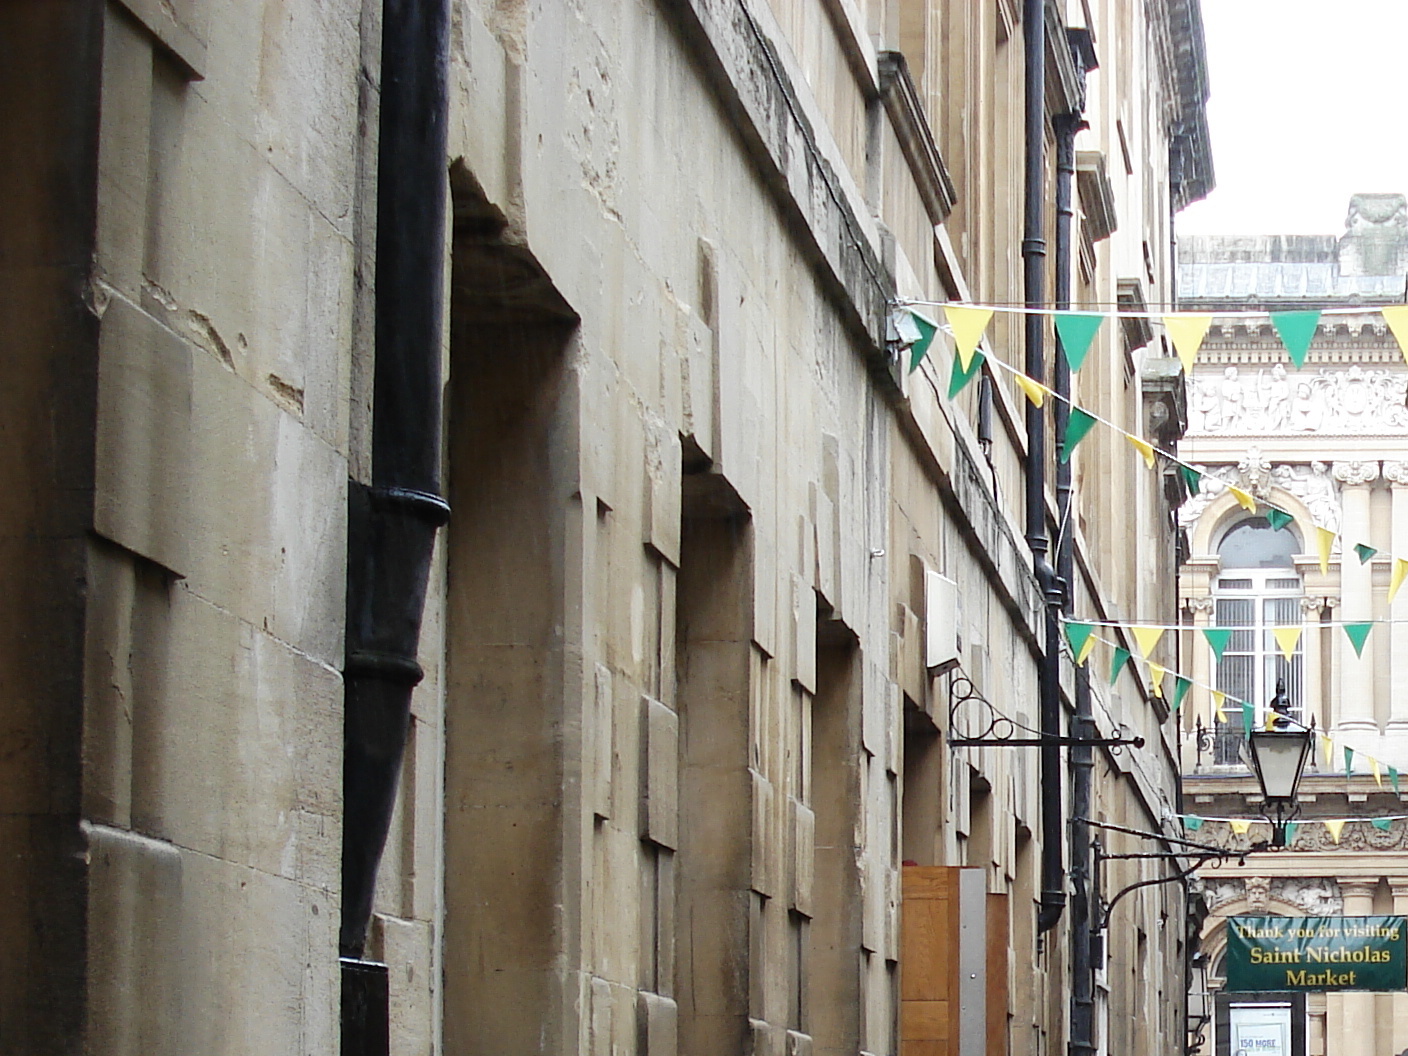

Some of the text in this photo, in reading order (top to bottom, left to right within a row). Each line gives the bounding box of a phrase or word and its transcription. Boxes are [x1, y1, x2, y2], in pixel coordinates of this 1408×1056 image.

[1238, 924, 1400, 942] Thank you for visiting
[1250, 945, 1391, 964] Saint Nicholas
[1285, 969, 1357, 986] Market
